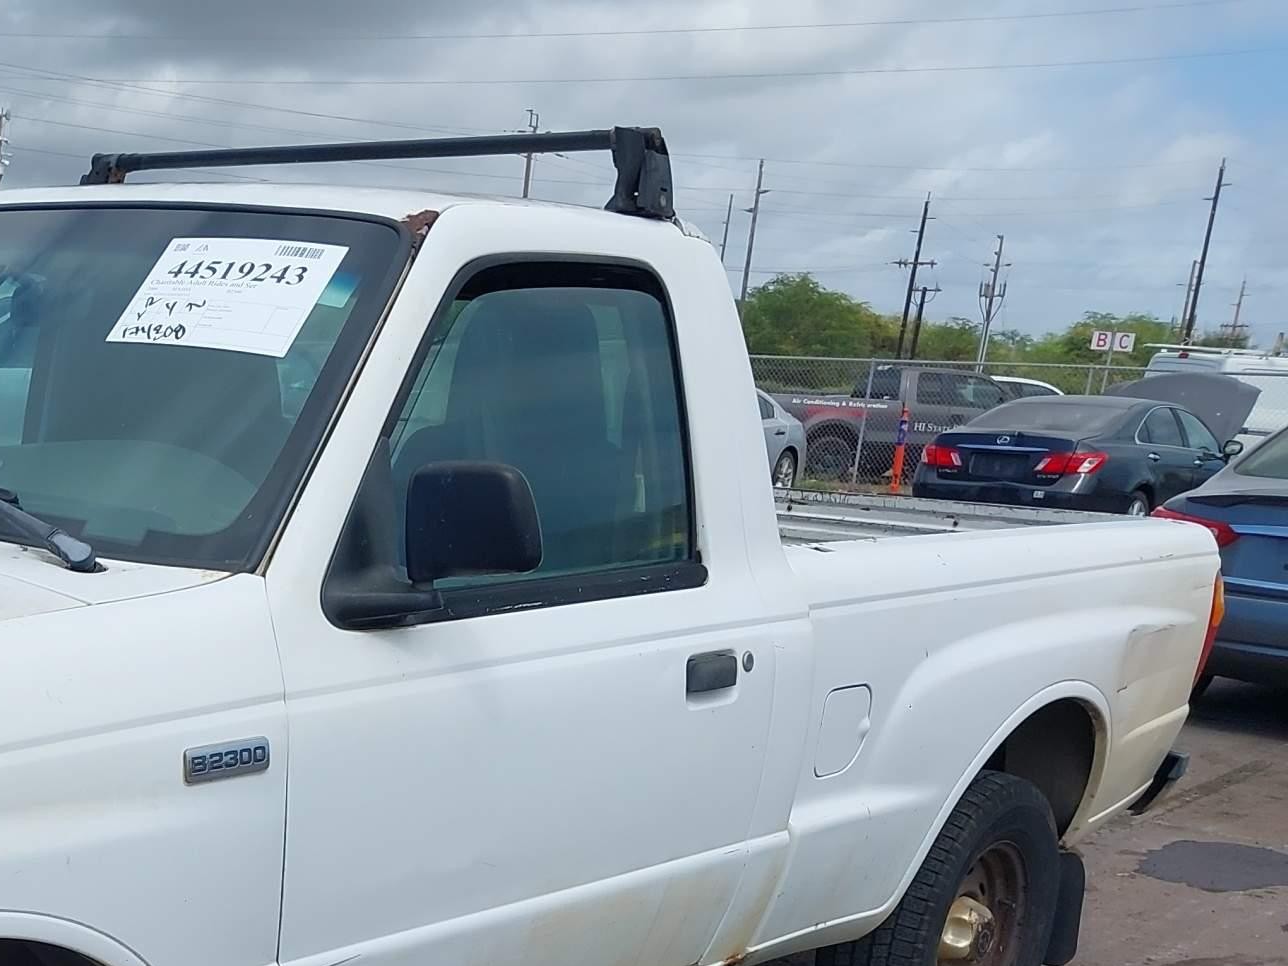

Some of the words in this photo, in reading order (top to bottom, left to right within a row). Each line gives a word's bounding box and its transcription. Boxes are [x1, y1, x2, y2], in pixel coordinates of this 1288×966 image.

[167, 259, 309, 286] 44519243
[207, 280, 228, 288] Rides
[1095, 332, 1108, 348] B
[1119, 334, 1130, 349] C
[791, 397, 802, 405] Air
[803, 398, 840, 408] Conditioning
[913, 422, 926, 432] HI
[191, 745, 267, 774] B2300
